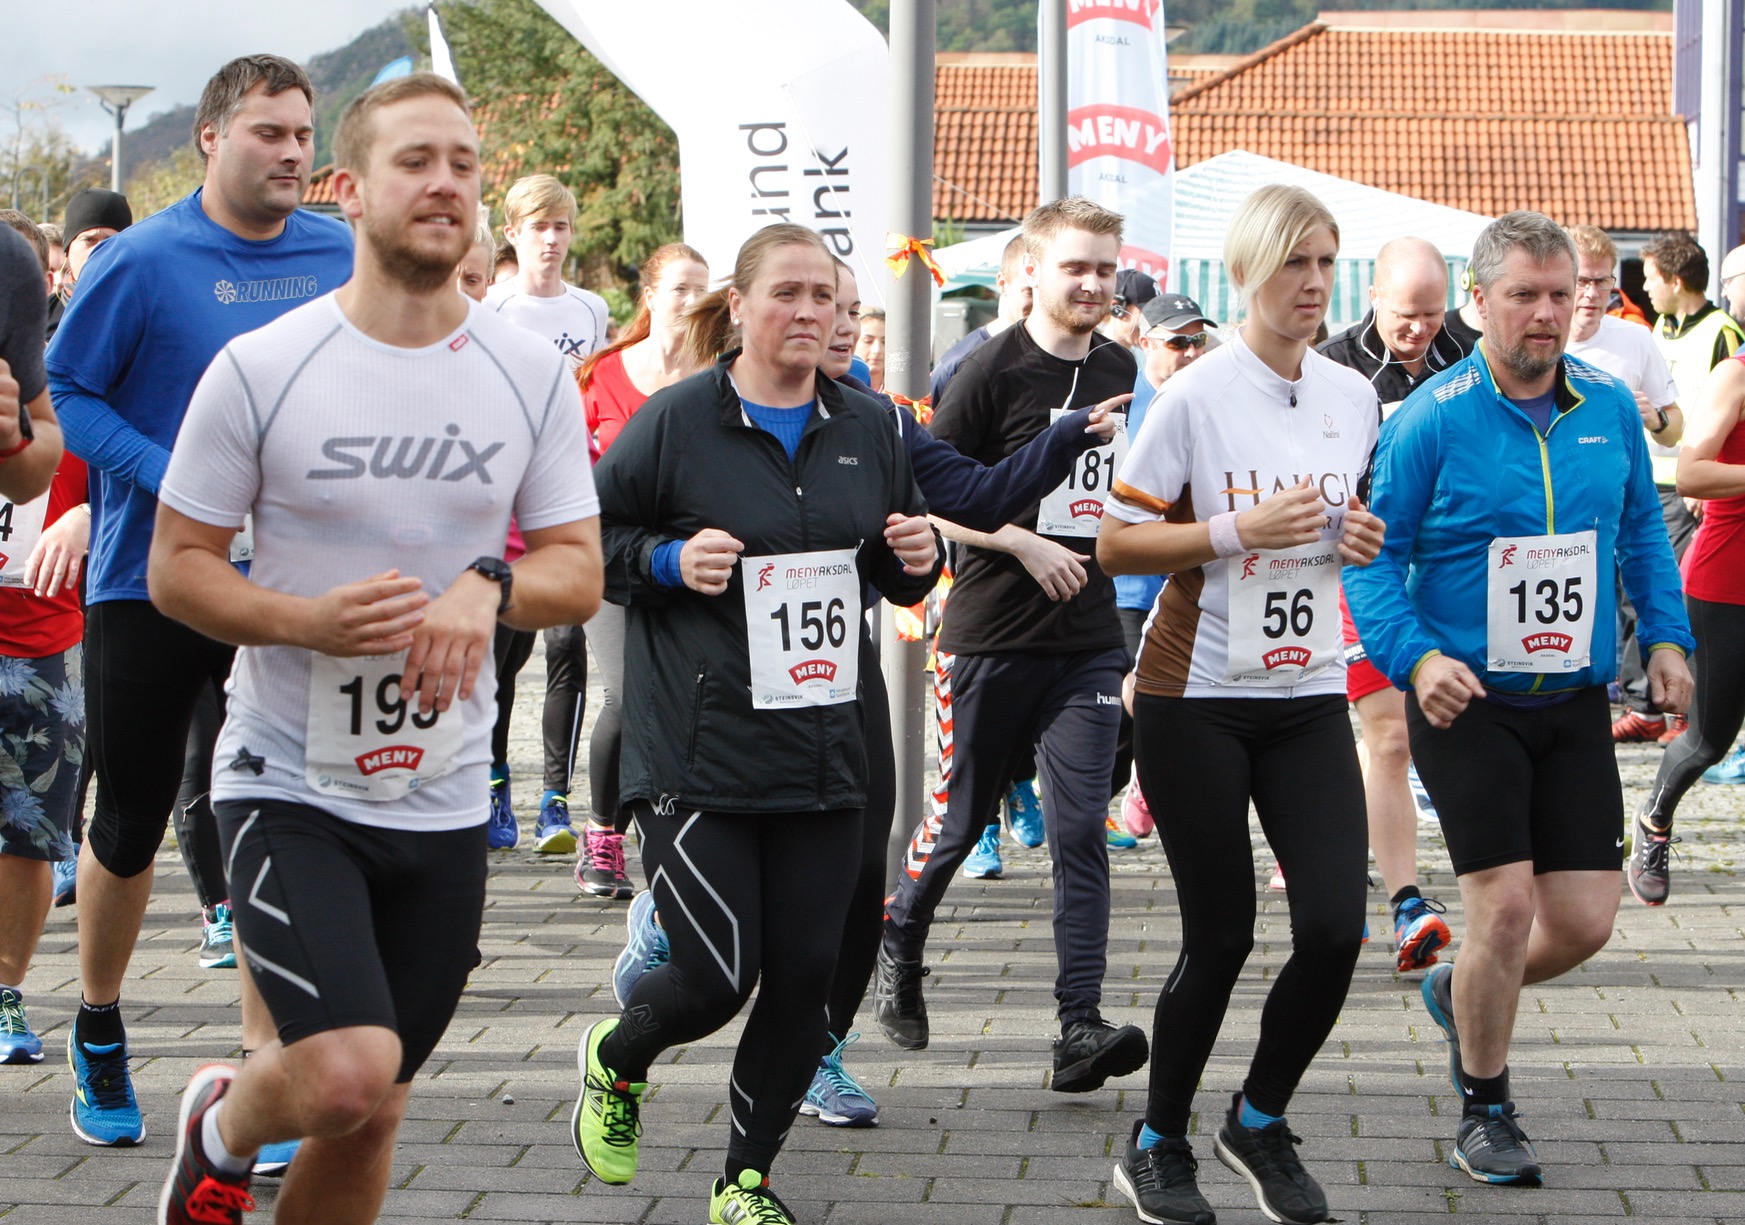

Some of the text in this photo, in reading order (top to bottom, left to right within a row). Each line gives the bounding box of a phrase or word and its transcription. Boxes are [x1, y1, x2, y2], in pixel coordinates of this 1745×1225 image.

[1068, 115, 1167, 156] MENY
[236, 275, 318, 302] RUNNING
[1578, 436, 1601, 444] CRAFT
[1073, 502, 1102, 514] MENY
[1526, 558, 1556, 570] LØPET
[1268, 568, 1300, 580] LØPET
[786, 577, 819, 590] LØPET
[1510, 577, 1583, 624] 135
[1263, 589, 1314, 639] 56
[770, 598, 846, 652] 156
[1527, 636, 1568, 649] MENY
[1267, 650, 1308, 666] MENY
[795, 663, 833, 680] MENY
[363, 750, 418, 770] MENY
